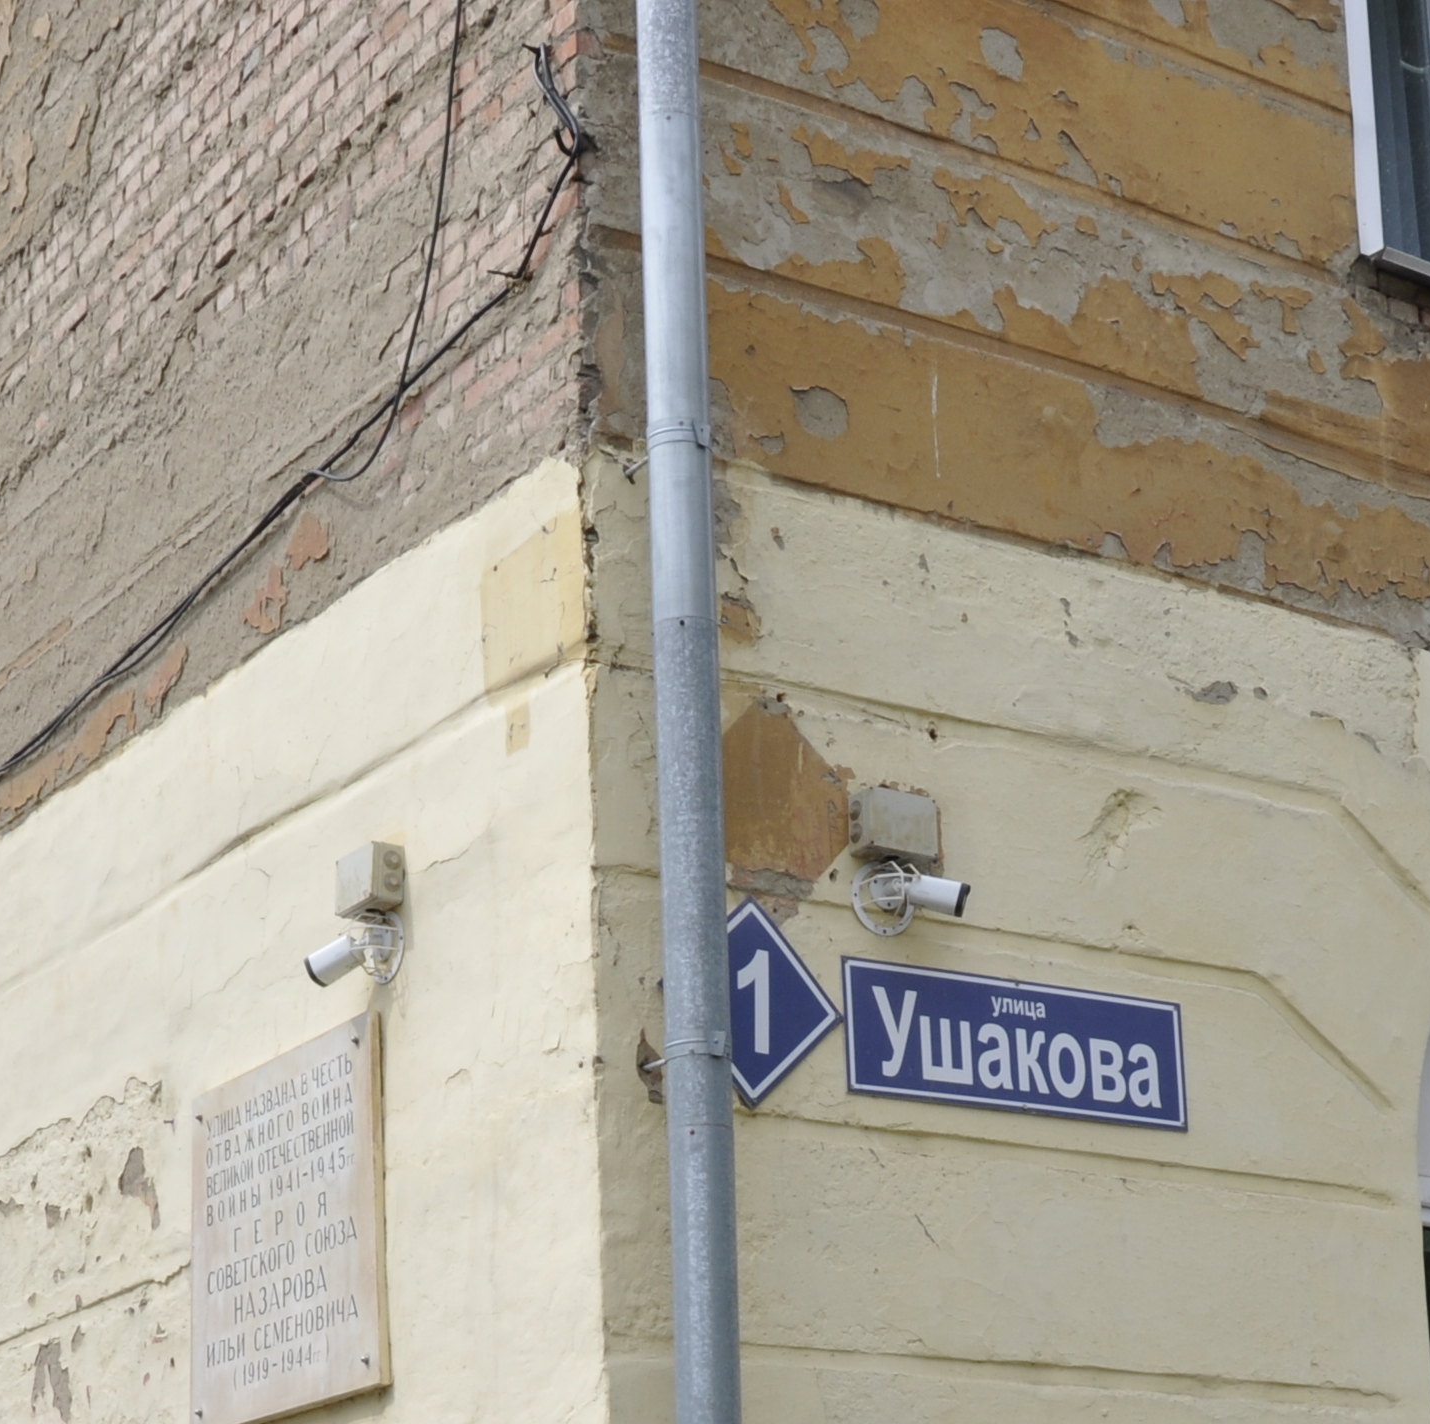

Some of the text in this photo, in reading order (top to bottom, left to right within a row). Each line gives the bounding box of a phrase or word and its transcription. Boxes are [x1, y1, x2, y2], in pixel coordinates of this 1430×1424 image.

[736, 948, 771, 1055] 1
[990, 993, 1047, 1020] улица
[871, 985, 1162, 1109] Ушакова
[206, 1053, 353, 1140] УЛИЦА НАЗВАНА В ЧЕСТЬ
[206, 1082, 353, 1169] ОТВАЖНОГО ВОИНА
[206, 1108, 354, 1199] ВЕЛИКОЙ ОТЕЧЕСТВЕННОЙ
[206, 1183, 261, 1227] ВОЙНЫ
[233, 1191, 327, 1252] ГЕРОЯ
[207, 1216, 357, 1295] СОВЕТСКОГО СОЮЗА
[234, 1264, 327, 1325] НАЗАРОВА
[206, 1294, 359, 1369] ИЛЬИ СЕМЕНОВИЧА
